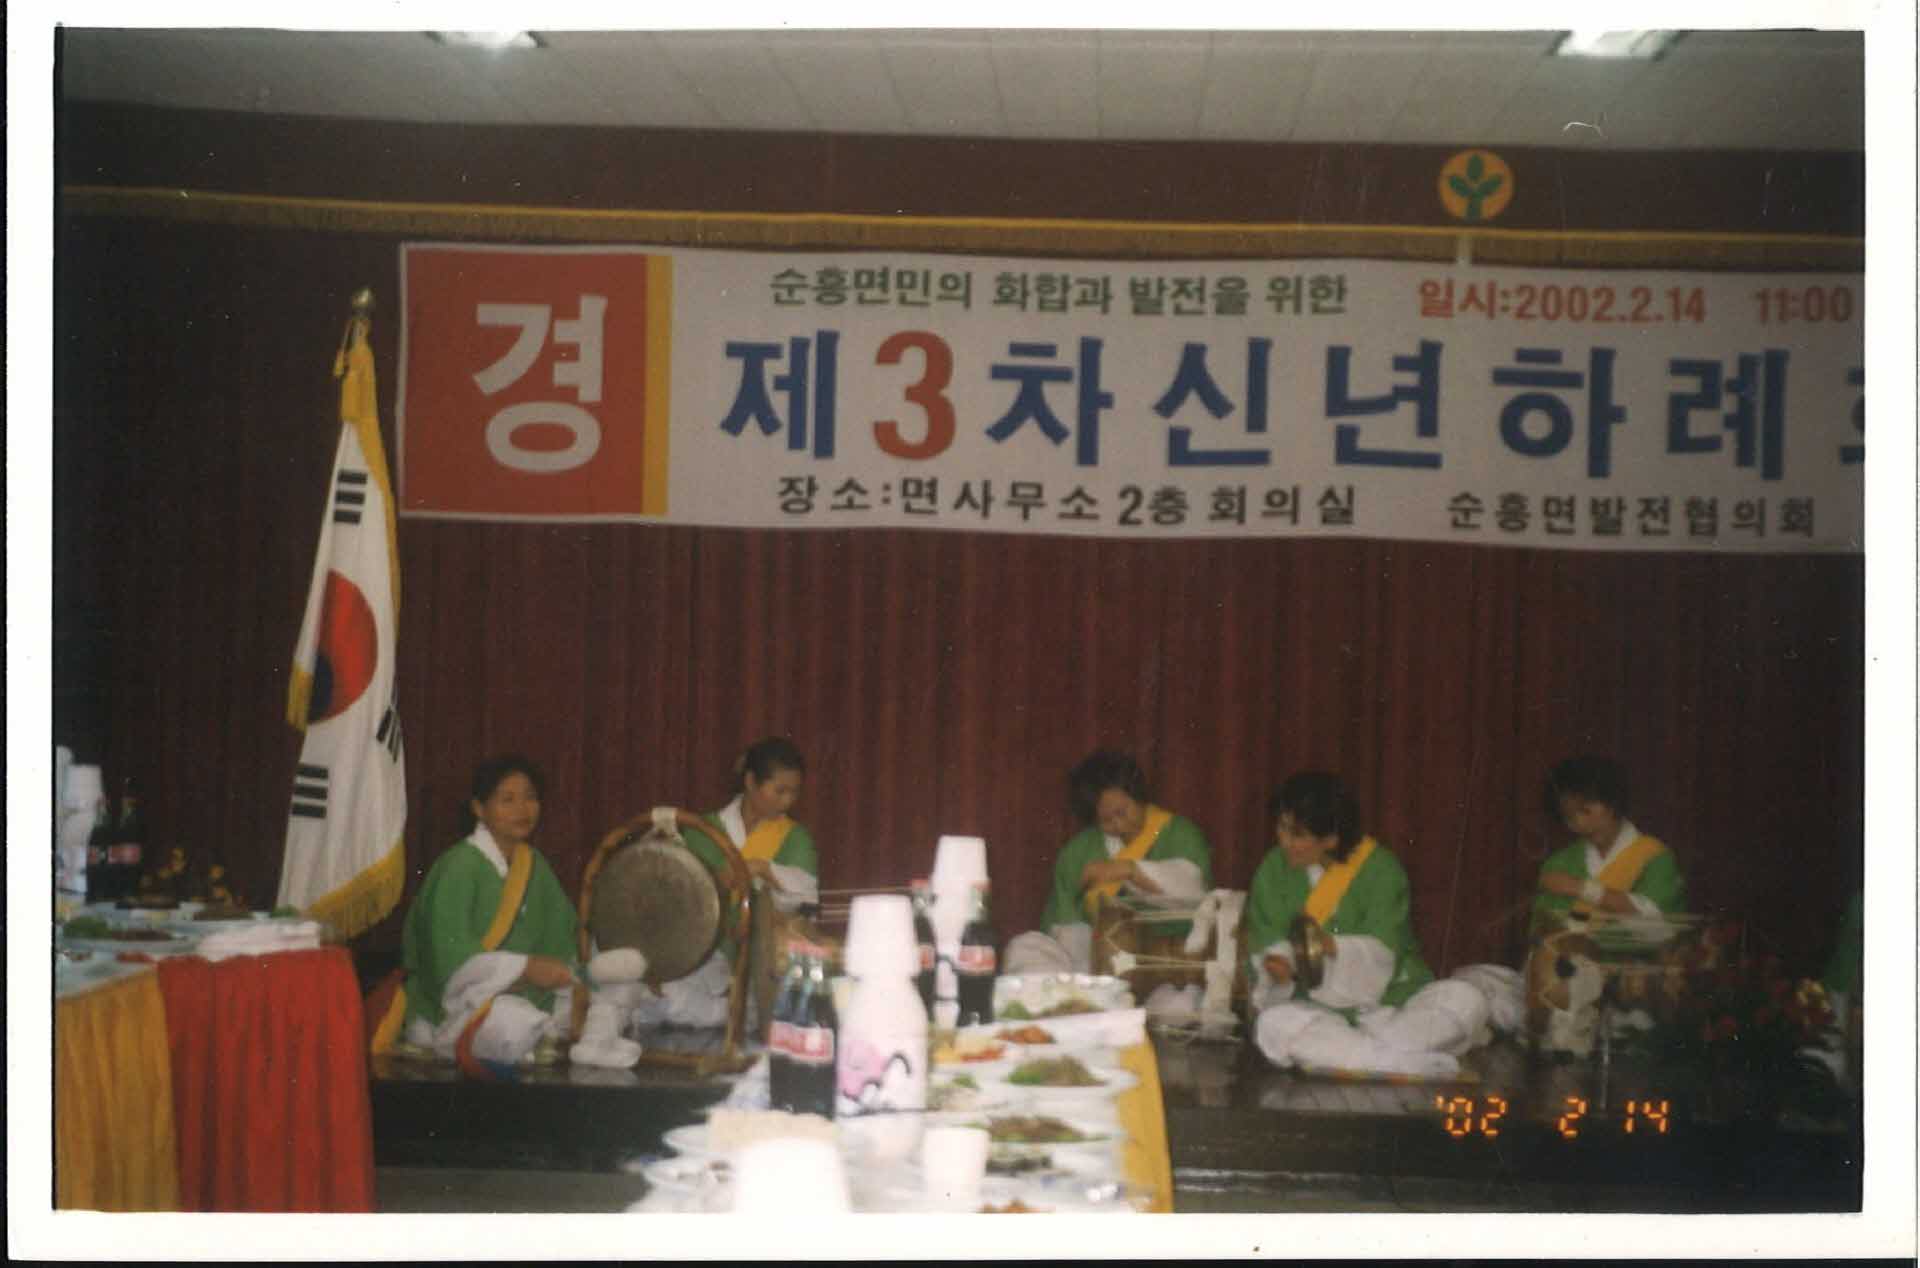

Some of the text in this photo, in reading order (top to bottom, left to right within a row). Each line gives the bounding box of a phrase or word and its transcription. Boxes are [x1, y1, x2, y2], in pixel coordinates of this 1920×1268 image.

[769, 266, 1347, 316] 순흥면민의 화합과 발전을 위한
[1419, 277, 1853, 325] 일시:2002.2.14 11:00
[471, 294, 608, 474] 경
[719, 329, 1865, 482] 제3차신년하례
[1208, 484, 1355, 526] 회의실
